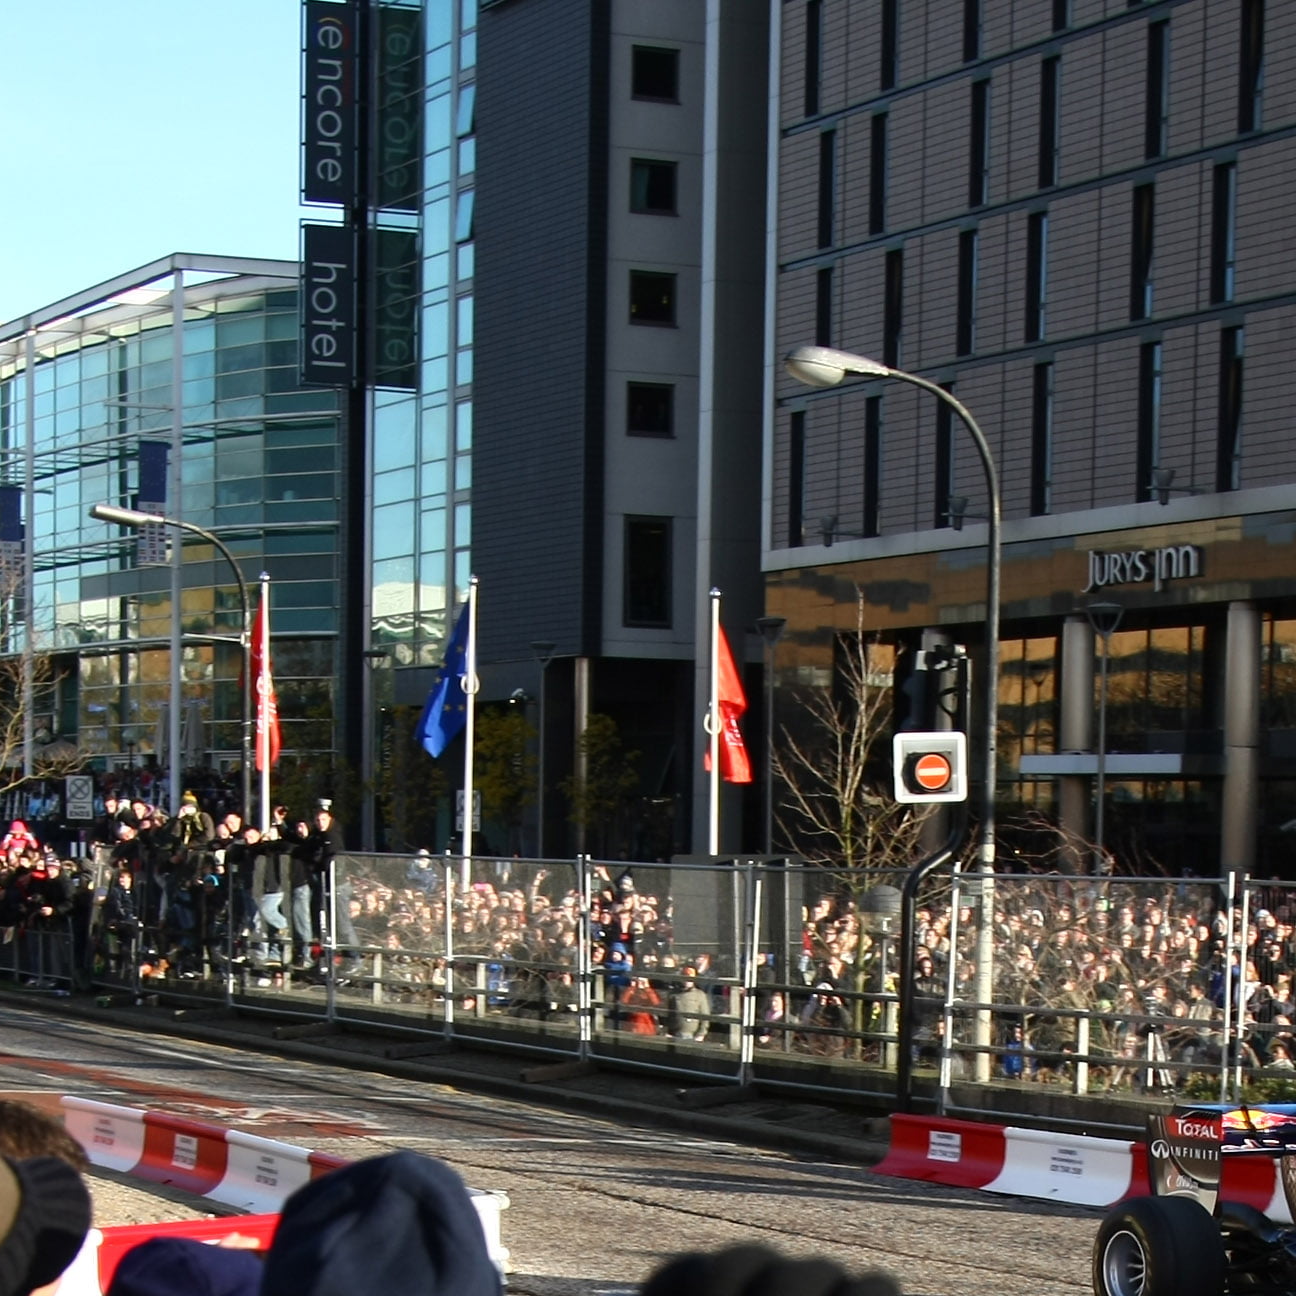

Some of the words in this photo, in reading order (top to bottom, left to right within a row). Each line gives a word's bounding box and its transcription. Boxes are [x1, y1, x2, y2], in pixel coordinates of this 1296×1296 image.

[316, 25, 342, 182] encore
[311, 261, 347, 367] hotel
[1169, 1145, 1219, 1161] INFINITI
[1175, 1118, 1219, 1139] TOTAL
